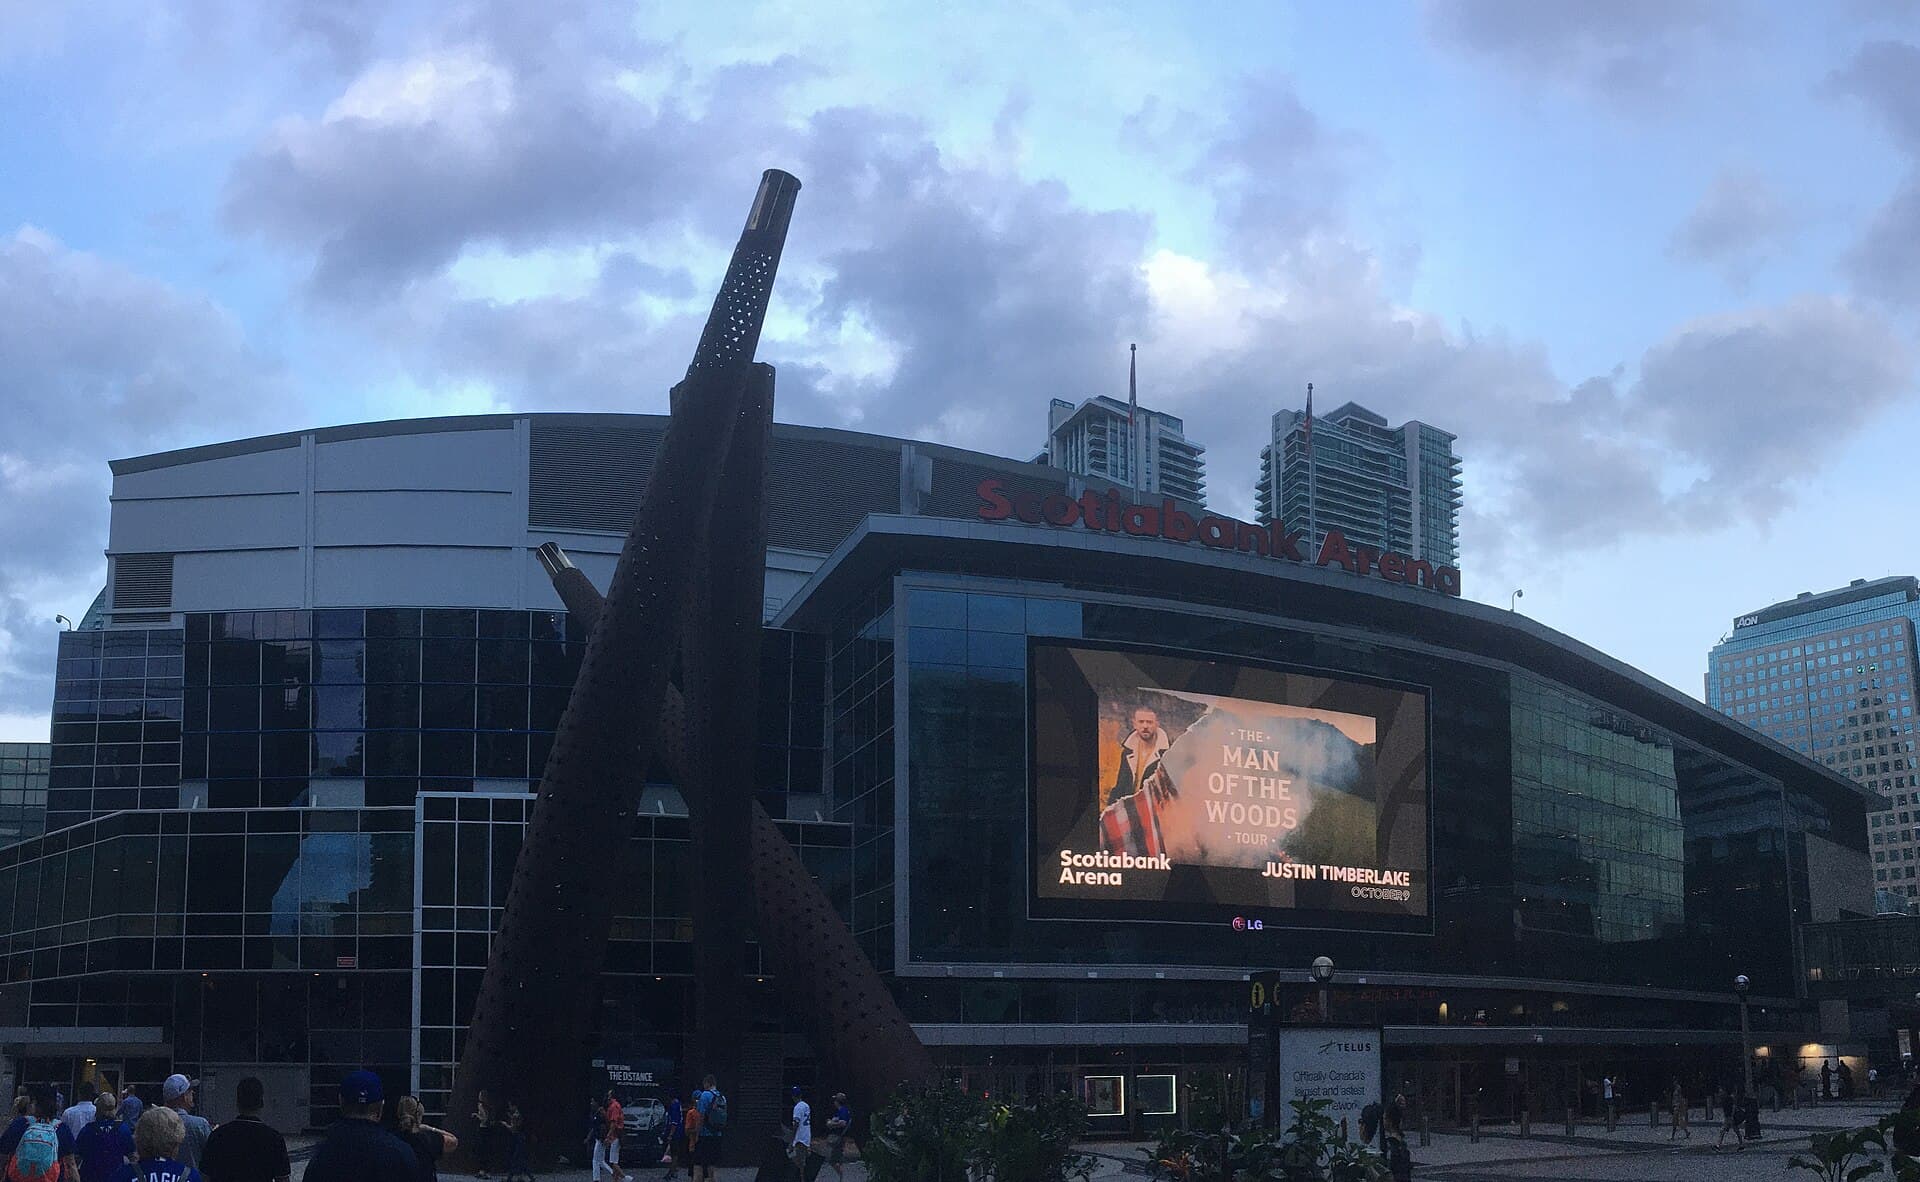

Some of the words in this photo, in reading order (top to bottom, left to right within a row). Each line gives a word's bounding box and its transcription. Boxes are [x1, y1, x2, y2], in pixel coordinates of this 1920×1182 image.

[977, 479, 1301, 562] Scotiabank
[1316, 529, 1461, 596] Arena
[1238, 729, 1264, 742] THE
[1223, 745, 1280, 771] MAN
[1208, 772, 1239, 795] OF
[1243, 775, 1291, 800] THE
[1204, 799, 1297, 829] WOODS
[1235, 832, 1268, 846] TOUR
[1060, 850, 1171, 870] Scotiabank
[1059, 867, 1122, 885] Arena
[1262, 862, 1316, 879] JUSTIN
[1320, 865, 1410, 886] TIMBERLAKE
[1247, 919, 1263, 930] LG
[1337, 1043, 1371, 1052] TELUS
